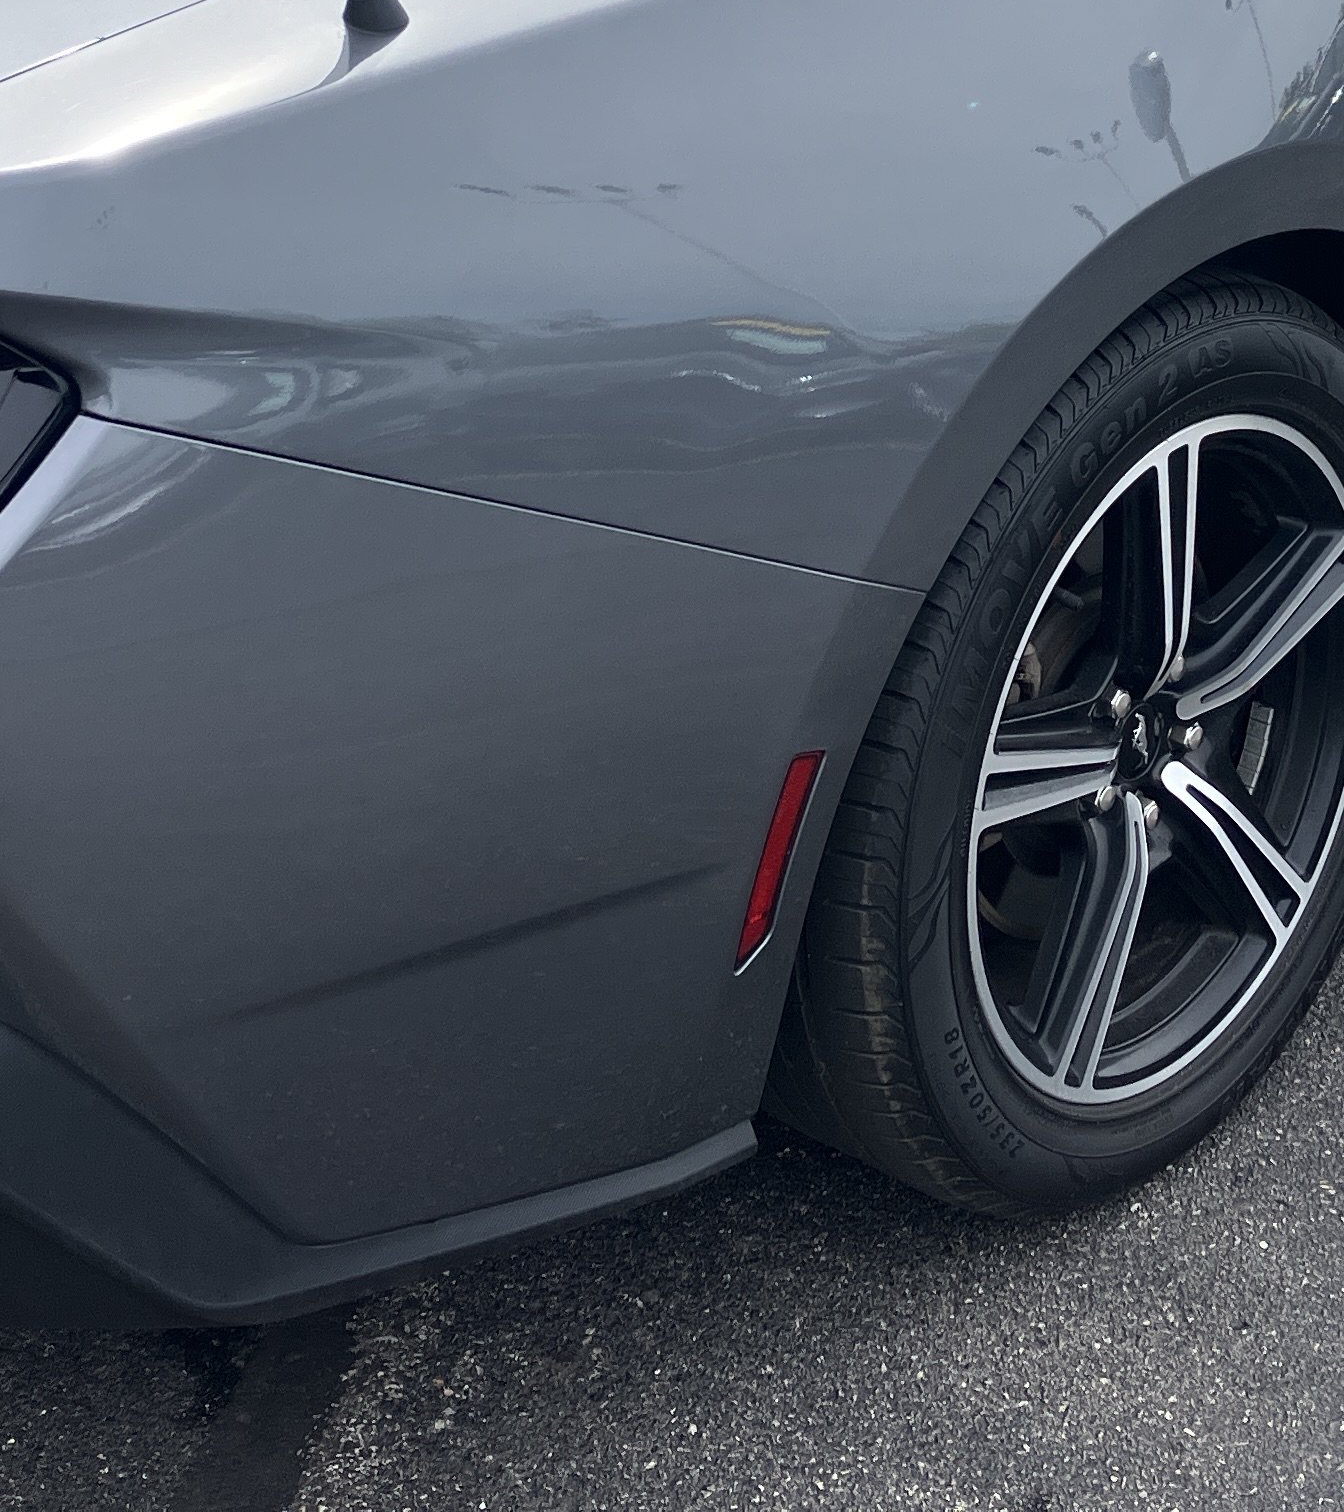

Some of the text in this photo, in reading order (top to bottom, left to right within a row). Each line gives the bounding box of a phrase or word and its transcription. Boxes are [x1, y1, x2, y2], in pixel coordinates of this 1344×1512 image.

[1070, 389, 1148, 488] Gen
[1156, 364, 1181, 410] 2
[1188, 336, 1235, 380] AS
